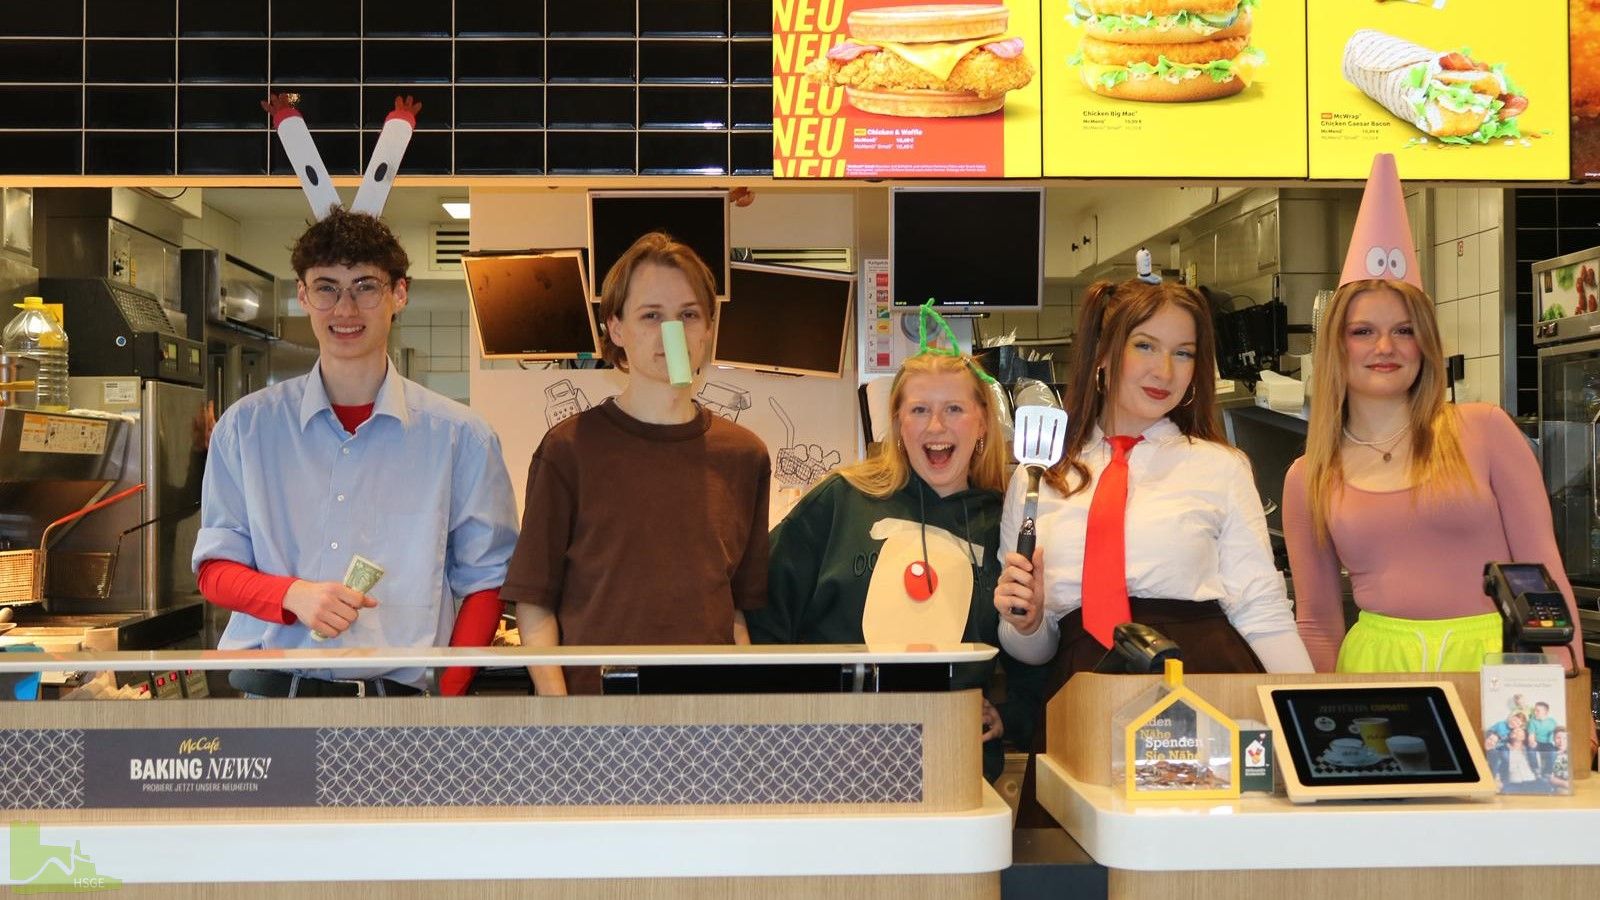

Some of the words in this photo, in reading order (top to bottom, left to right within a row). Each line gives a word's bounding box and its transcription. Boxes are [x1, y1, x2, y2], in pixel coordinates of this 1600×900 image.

[773, 0, 845, 33] NEU
[773, 75, 845, 116] NEU
[773, 117, 847, 158] NEU
[179, 736, 222, 754] McCafé
[1145, 736, 1203, 750] Spenden
[130, 758, 203, 780] BAKING
[206, 756, 273, 780] NEWS!
[142, 783, 174, 792] PROBIERE
[174, 783, 195, 792] JETZT
[195, 782, 222, 792] UNSERE
[222, 782, 258, 792] NEUHEITEN
